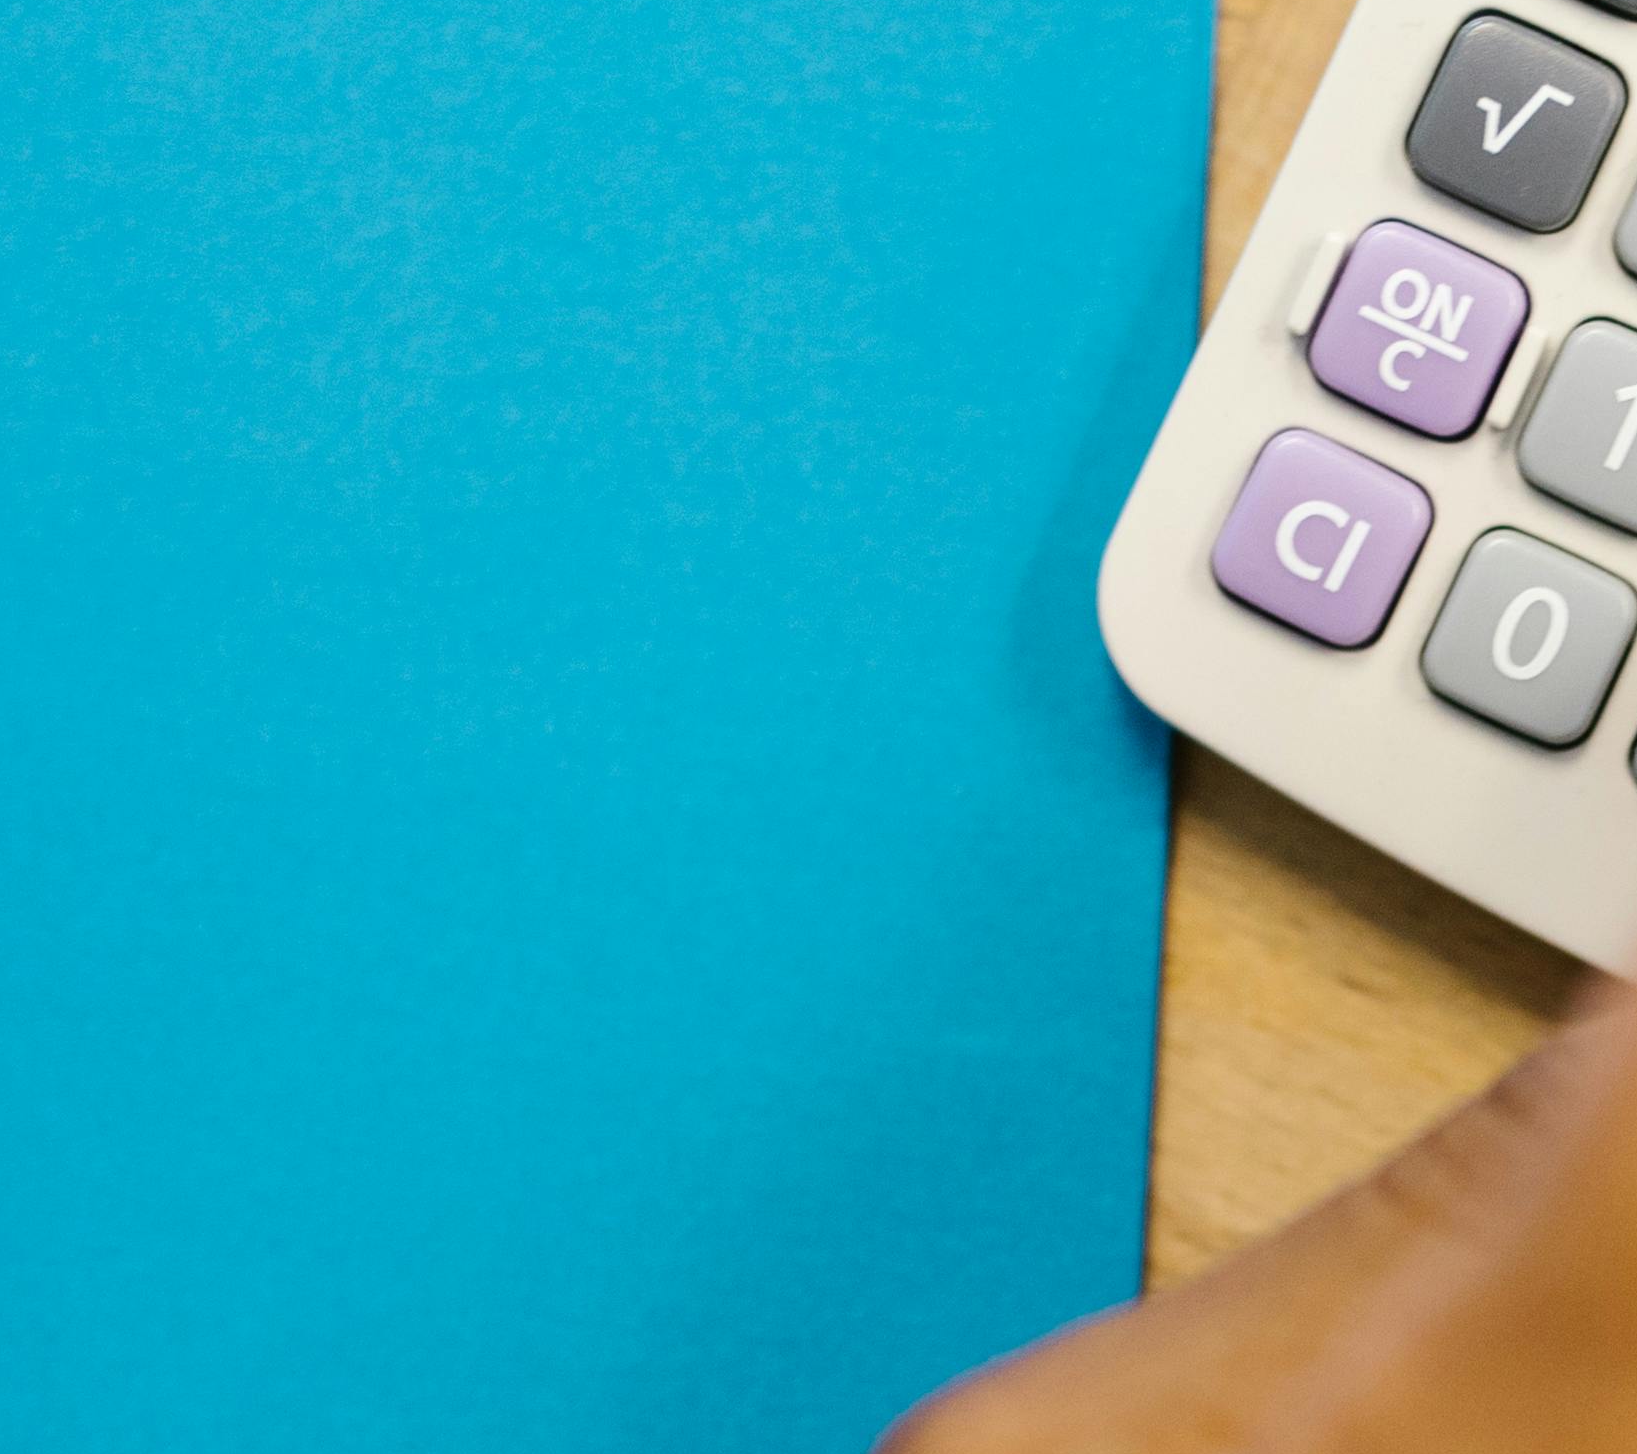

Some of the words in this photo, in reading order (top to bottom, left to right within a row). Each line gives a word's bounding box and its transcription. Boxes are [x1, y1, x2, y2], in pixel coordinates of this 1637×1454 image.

[1380, 268, 1475, 343] ON
[1378, 339, 1427, 392] C
[1493, 587, 1568, 680] 0
